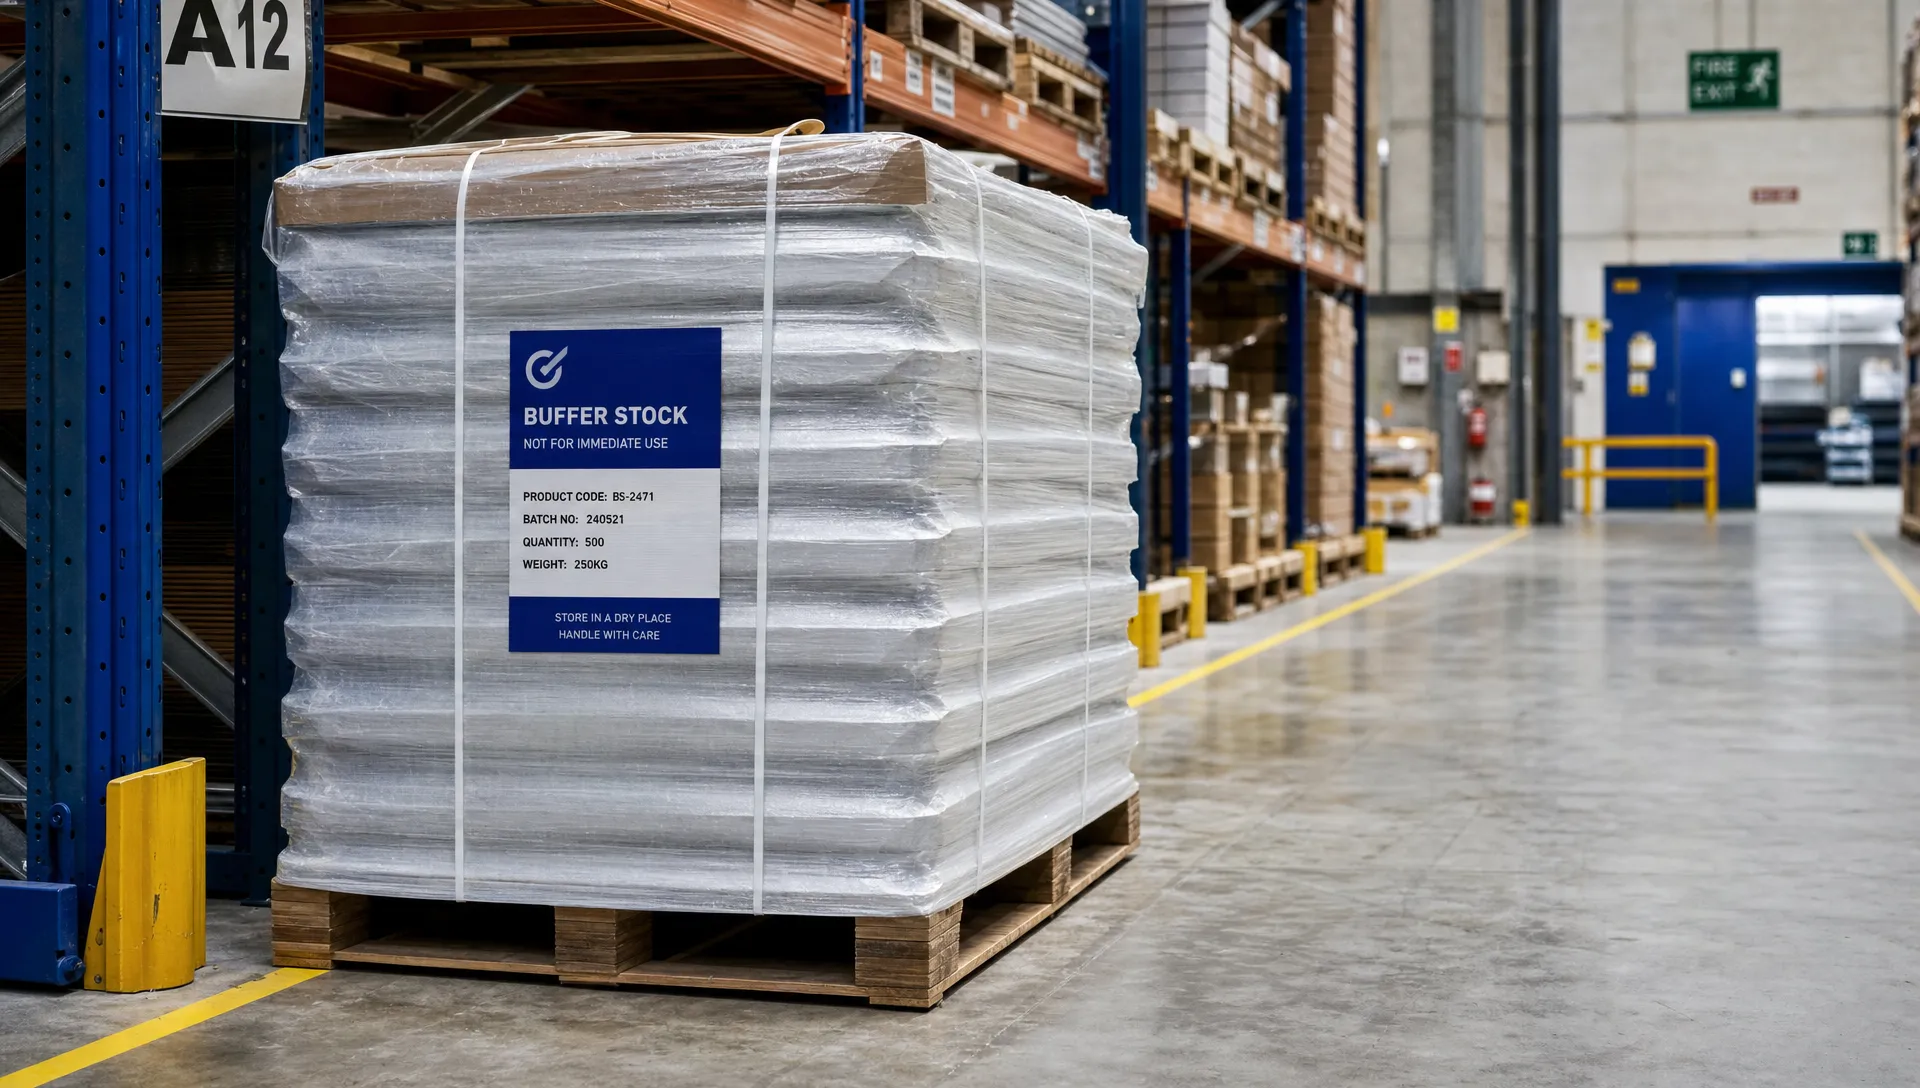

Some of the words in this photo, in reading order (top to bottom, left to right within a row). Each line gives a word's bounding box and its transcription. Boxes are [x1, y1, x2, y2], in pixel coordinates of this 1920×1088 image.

[165, 0, 290, 71] A12
[1693, 56, 1738, 76] FIRE
[1693, 81, 1737, 102] EXIT
[523, 406, 608, 426] BUFFER
[614, 405, 688, 425] STOCK
[523, 438, 548, 450] NOT
[550, 438, 574, 449] FOR
[577, 438, 642, 449] IMMEDIATE
[644, 437, 669, 449] USE
[523, 491, 574, 502] PRODUCT
[575, 491, 608, 502] CODE:
[612, 491, 655, 502] BS-2471
[523, 514, 559, 525] BATCH
[560, 514, 579, 525] NO:
[586, 514, 625, 525] 240521
[523, 537, 579, 548] QUANTITY:
[585, 537, 605, 548] 500
[523, 559, 567, 570] WEIGHT:
[574, 559, 609, 570] 250KG
[555, 612, 588, 623] STORE
[591, 613, 602, 623] IN
[604, 613, 612, 623] A
[614, 613, 635, 623] DRY
[638, 613, 672, 624] PLACE
[558, 630, 600, 641] HANDLE
[603, 630, 630, 641] WITH
[632, 630, 661, 641] CARE
